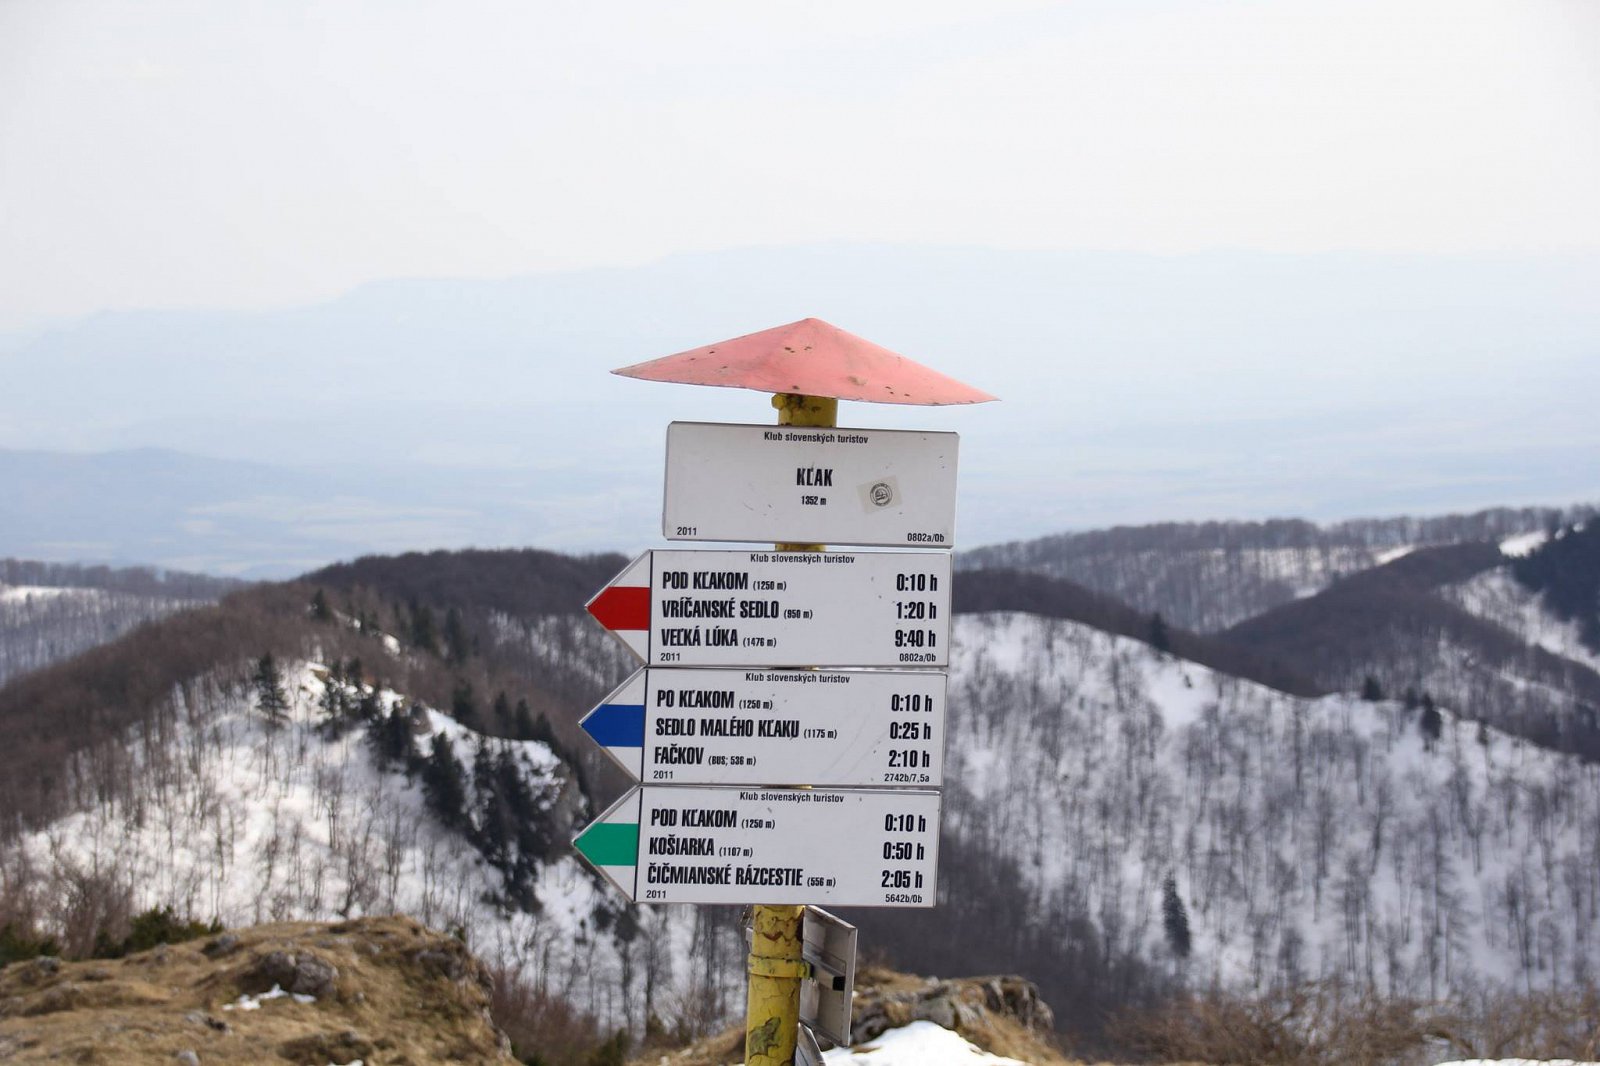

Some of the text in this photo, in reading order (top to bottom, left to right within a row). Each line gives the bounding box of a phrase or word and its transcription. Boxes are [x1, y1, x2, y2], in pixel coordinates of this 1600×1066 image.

[764, 432, 869, 445] Klub slovenských turistov
[797, 467, 833, 486] KĽAK
[802, 496, 827, 506] 1352 m
[677, 527, 697, 536] 2011
[907, 533, 945, 543] 0802a/0b
[751, 554, 856, 565] Klub slovenských turistov
[663, 571, 787, 592] POD KĽAKOM (1250 m)
[897, 574, 937, 591] 0:10 h
[662, 597, 814, 620] VRÍČANSKÉ SEDLO (950 m)
[896, 602, 936, 619] 1:20 h
[661, 625, 701, 646] VEĽKÁ
[706, 625, 738, 646] LÚKA
[767, 638, 777, 649] m)
[895, 629, 936, 647] 9:40 h
[661, 653, 681, 662] 2011
[899, 653, 937, 663] 0802a/0b
[746, 673, 851, 685] Klub slovenských turistov
[657, 690, 774, 711] PO KĽAKOM (1250 m)
[891, 694, 932, 712] 0:10 h
[656, 716, 838, 740] SEDLO MALÉHO KĽAKU (1175 m)
[890, 722, 931, 740] 0:25 h
[654, 743, 757, 767] FAČKOV (BUS; 536 m)
[889, 750, 930, 768] 2:10 h
[653, 770, 674, 780] 2011
[740, 792, 846, 804] Klub slovenských turistov
[651, 808, 776, 831] POD KĽAKOM (1250 m)
[885, 814, 926, 832] 0:10 h
[649, 834, 754, 859] KOŠIARKA (1107 m)
[883, 842, 924, 860] 0:50 h
[648, 862, 837, 889] ČIČMIANSKÉ RÁZCESTIE (556 m)
[881, 870, 923, 888] 2:05 h
[646, 890, 667, 899] 2011
[885, 894, 923, 904] 5642b/0b
